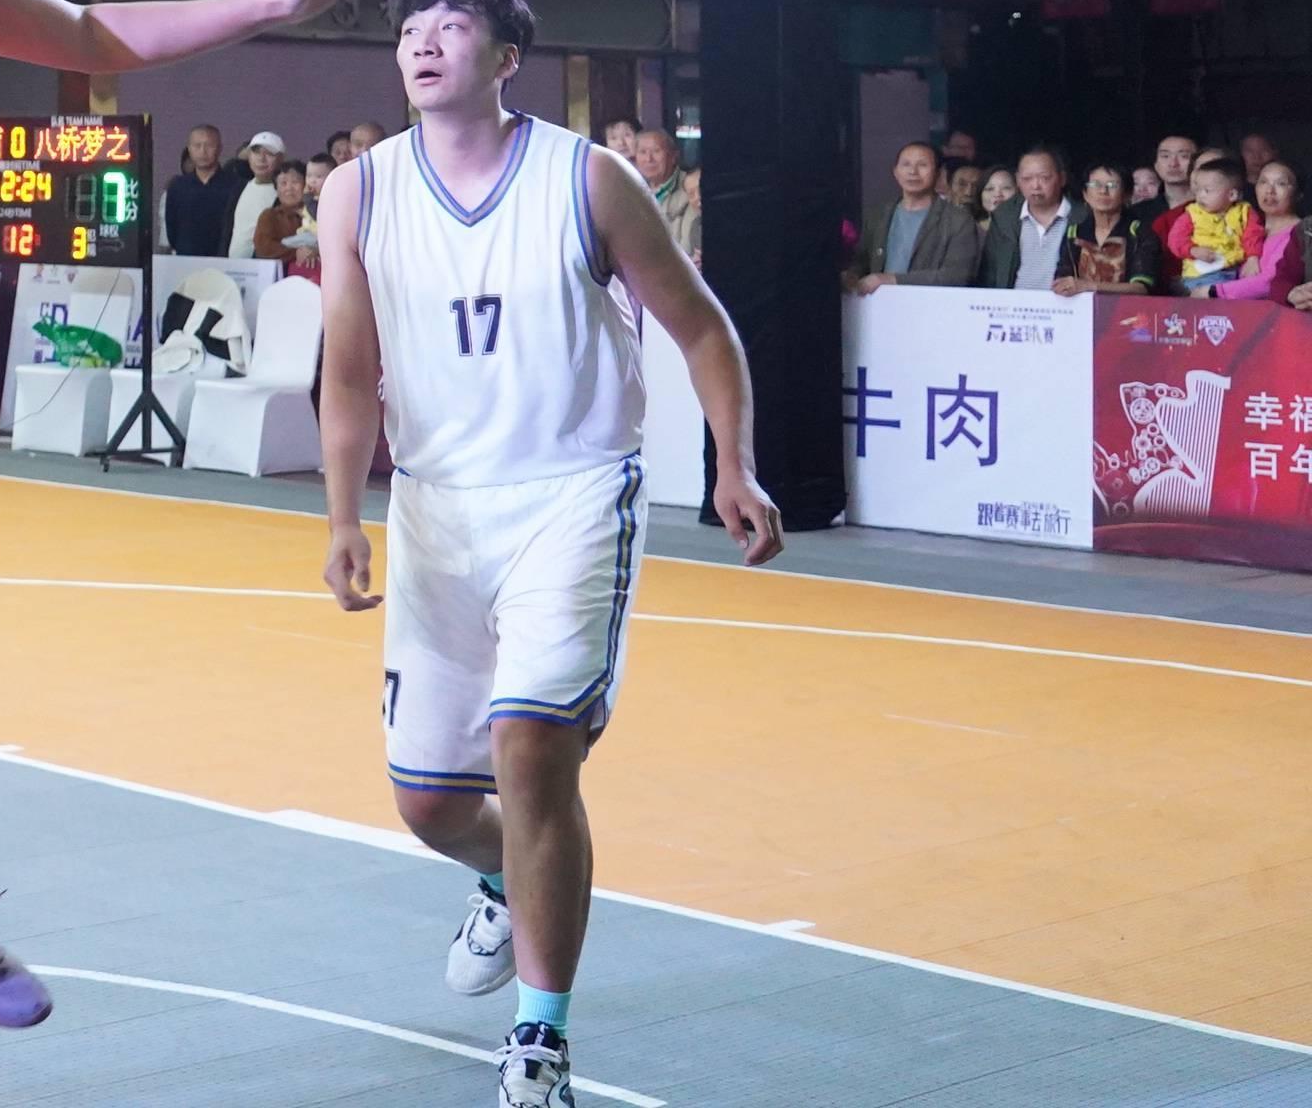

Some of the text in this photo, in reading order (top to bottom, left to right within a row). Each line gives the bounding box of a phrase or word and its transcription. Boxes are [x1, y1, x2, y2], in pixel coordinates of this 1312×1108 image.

[66, 115, 82, 126] TEAM
[84, 115, 103, 126] NAME
[10, 126, 26, 158] 0
[34, 126, 130, 161] 八桥梦之
[0, 170, 52, 203] 2:24
[103, 172, 126, 223] 7
[125, 178, 139, 221] 比分
[9, 224, 34, 256] 12
[72, 226, 87, 259] 3
[450, 293, 503, 357] 17
